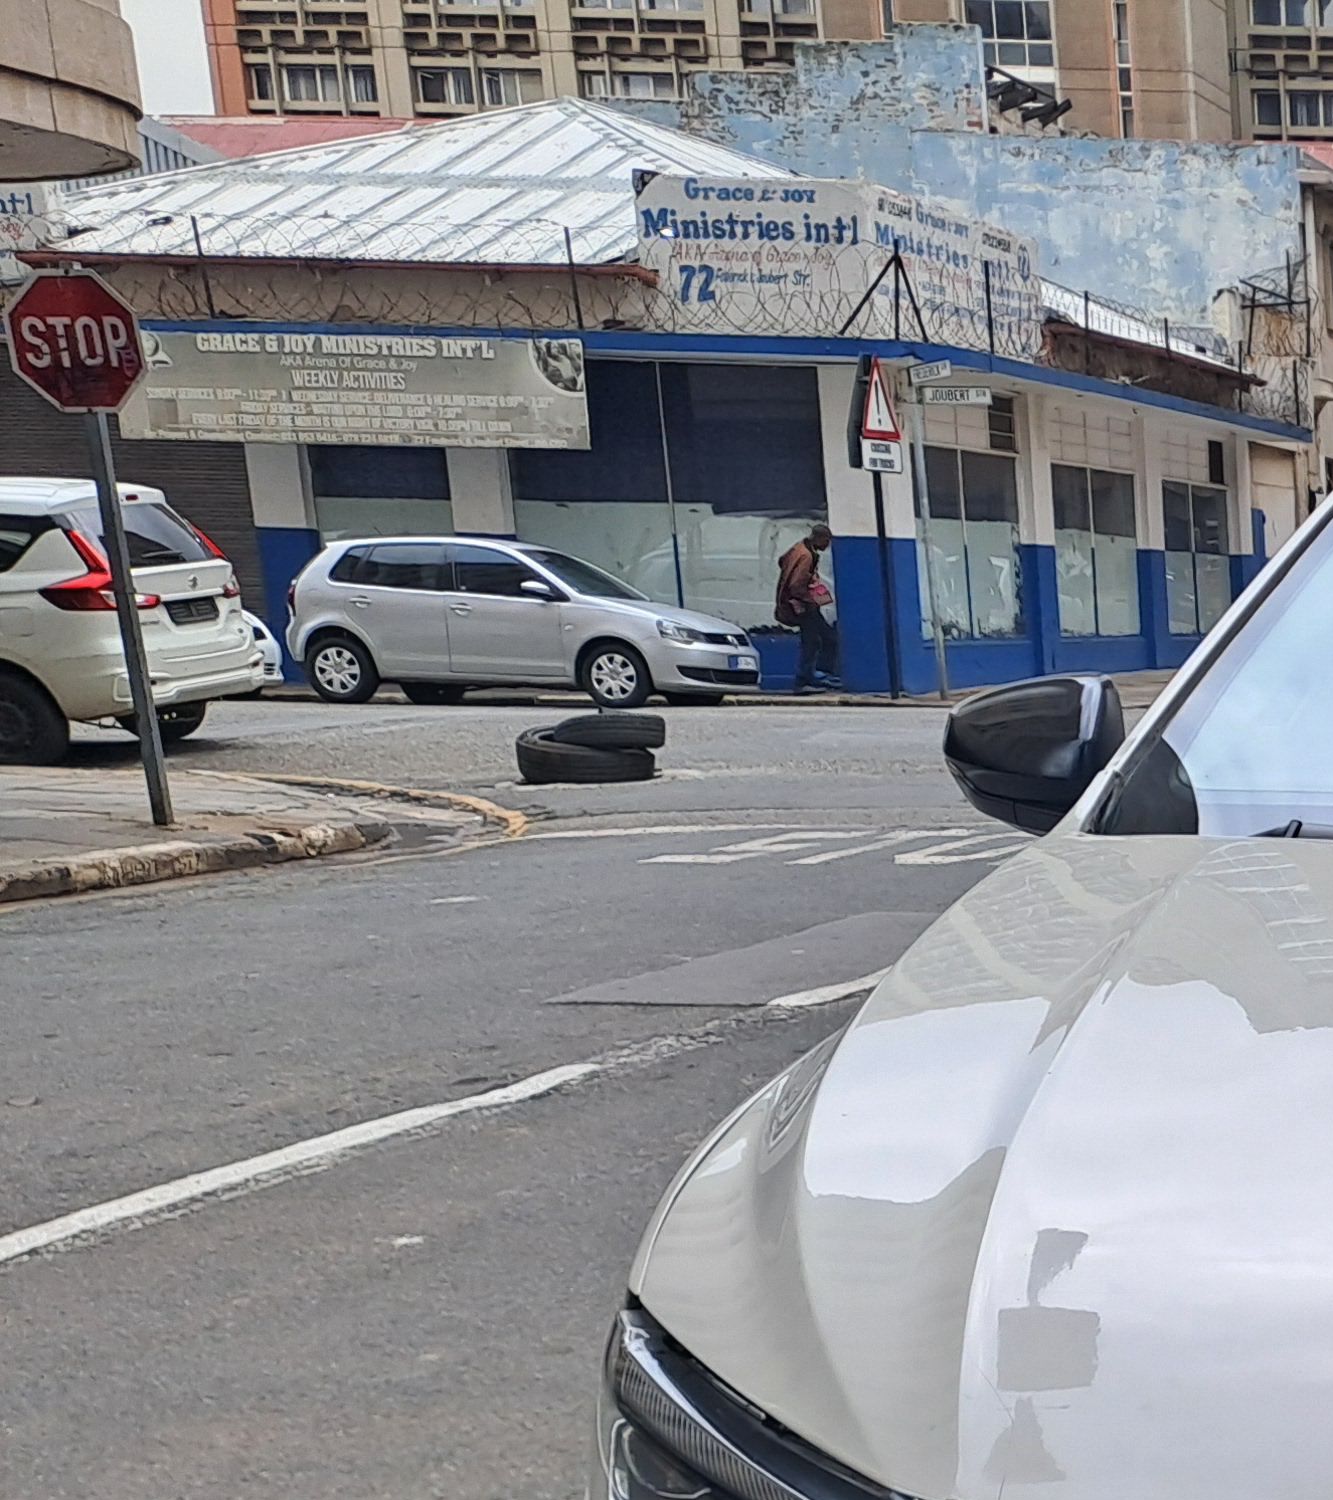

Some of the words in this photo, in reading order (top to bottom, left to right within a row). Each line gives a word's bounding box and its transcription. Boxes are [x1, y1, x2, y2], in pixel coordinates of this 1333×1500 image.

[684, 177, 754, 200] Grace
[640, 208, 795, 240] Ministries
[875, 221, 969, 269] Ministries
[679, 264, 716, 304] 72
[20, 315, 128, 369] STOP
[196, 334, 261, 353] GRACE
[265, 335, 279, 354] &
[283, 335, 315, 354] JOY
[320, 335, 437, 358] MINISTRIES
[441, 339, 495, 360] INT'L
[305, 356, 336, 368] Arena
[353, 357, 387, 369] Grace
[400, 359, 417, 372] Joy
[290, 370, 339, 388] WEEKLY
[342, 371, 406, 391] ACTIVITIES
[929, 389, 970, 402] JOUBERT
